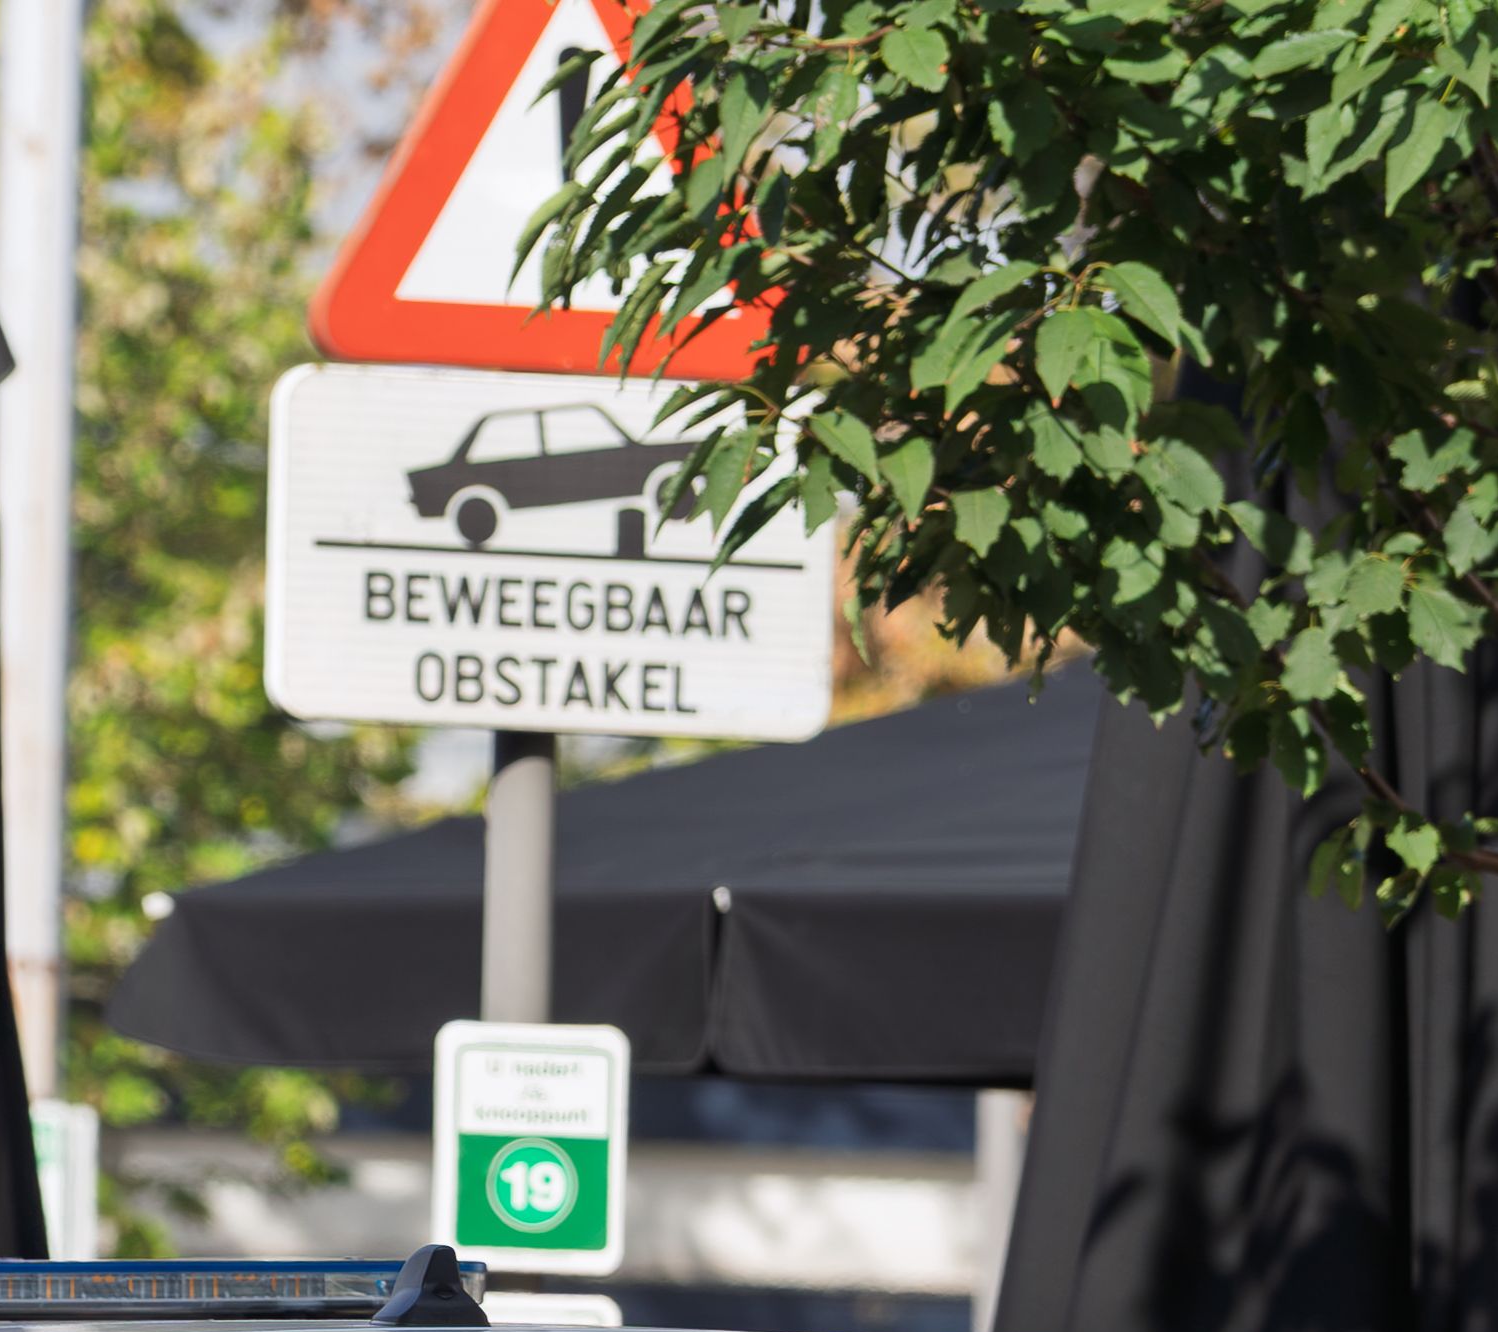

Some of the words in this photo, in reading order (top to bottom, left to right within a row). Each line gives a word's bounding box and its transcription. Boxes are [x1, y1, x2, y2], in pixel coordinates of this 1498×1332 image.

[364, 571, 752, 640] BEWEEGBAAR
[415, 650, 698, 714] OBSTAKEL
[500, 1161, 567, 1212] 19
